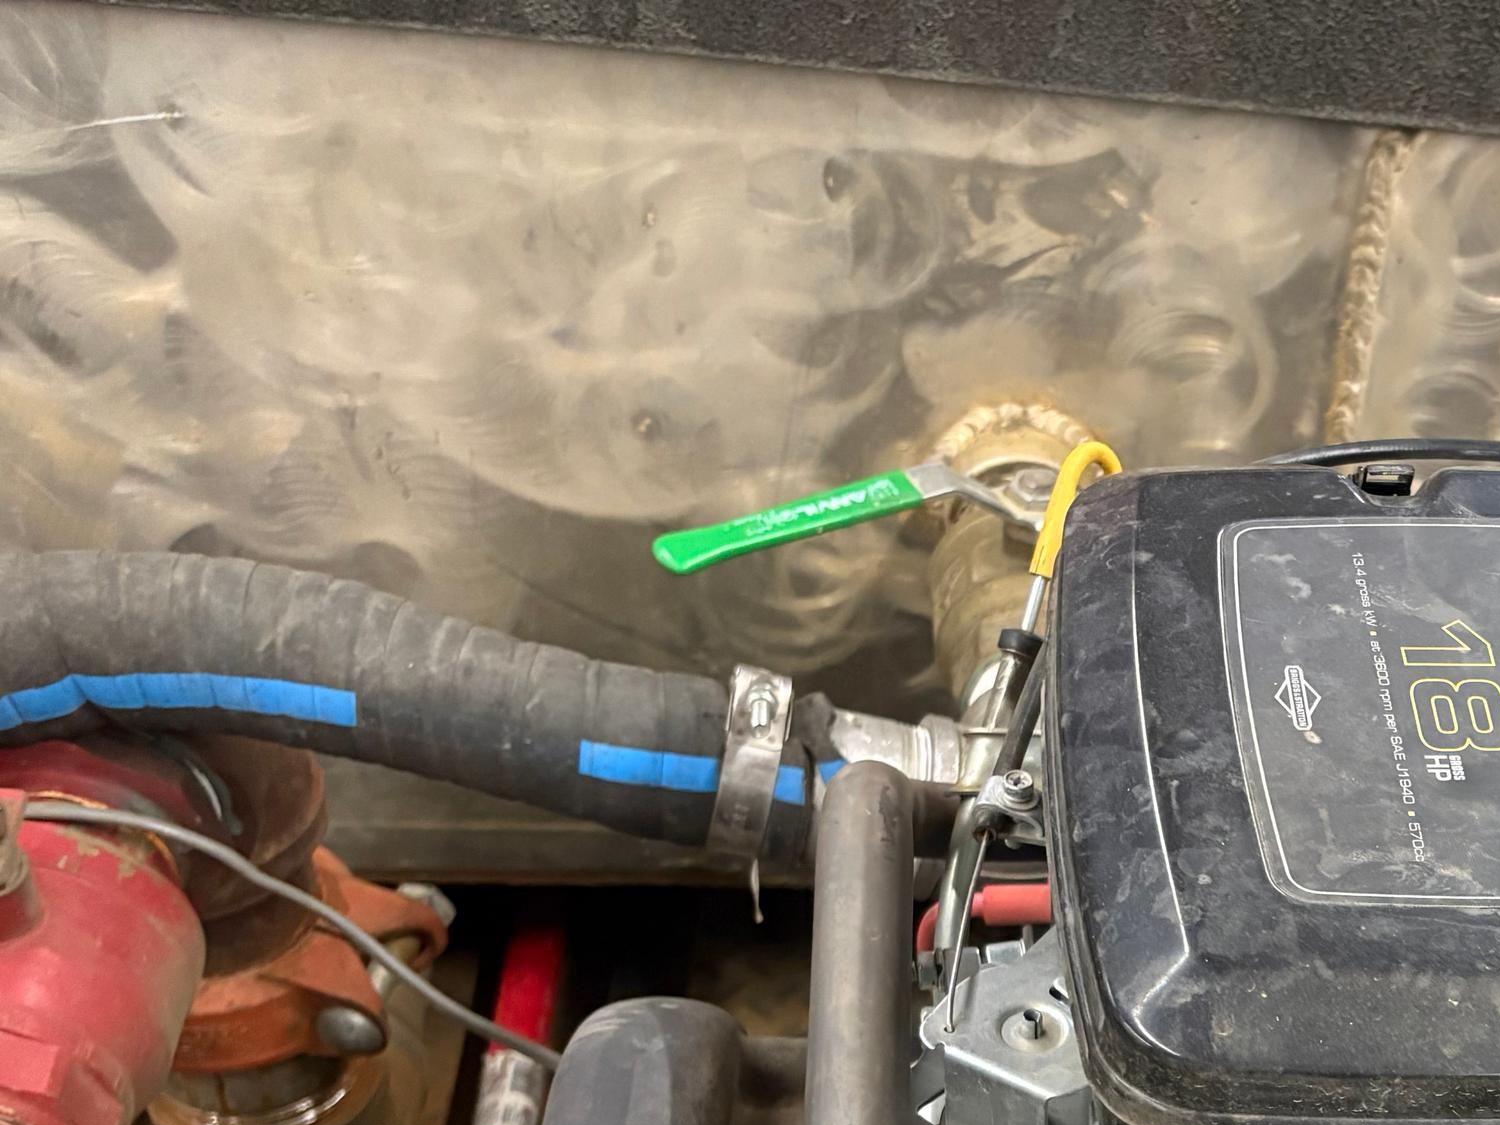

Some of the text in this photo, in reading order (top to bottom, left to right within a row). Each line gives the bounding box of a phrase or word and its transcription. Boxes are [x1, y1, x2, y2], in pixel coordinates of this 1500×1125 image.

[1351, 552, 1367, 576] 13.4
[1355, 579, 1371, 608] gross
[1364, 610, 1378, 627] kW
[1370, 640, 1381, 652] at
[1374, 653, 1390, 686] 3600
[1379, 688, 1393, 711] rpm
[1383, 713, 1397, 733] per
[1390, 736, 1407, 761] SAE
[1424, 755, 1452, 781] HP
[1449, 755, 1466, 781] GROSS
[1408, 822, 1425, 863] 570cc
